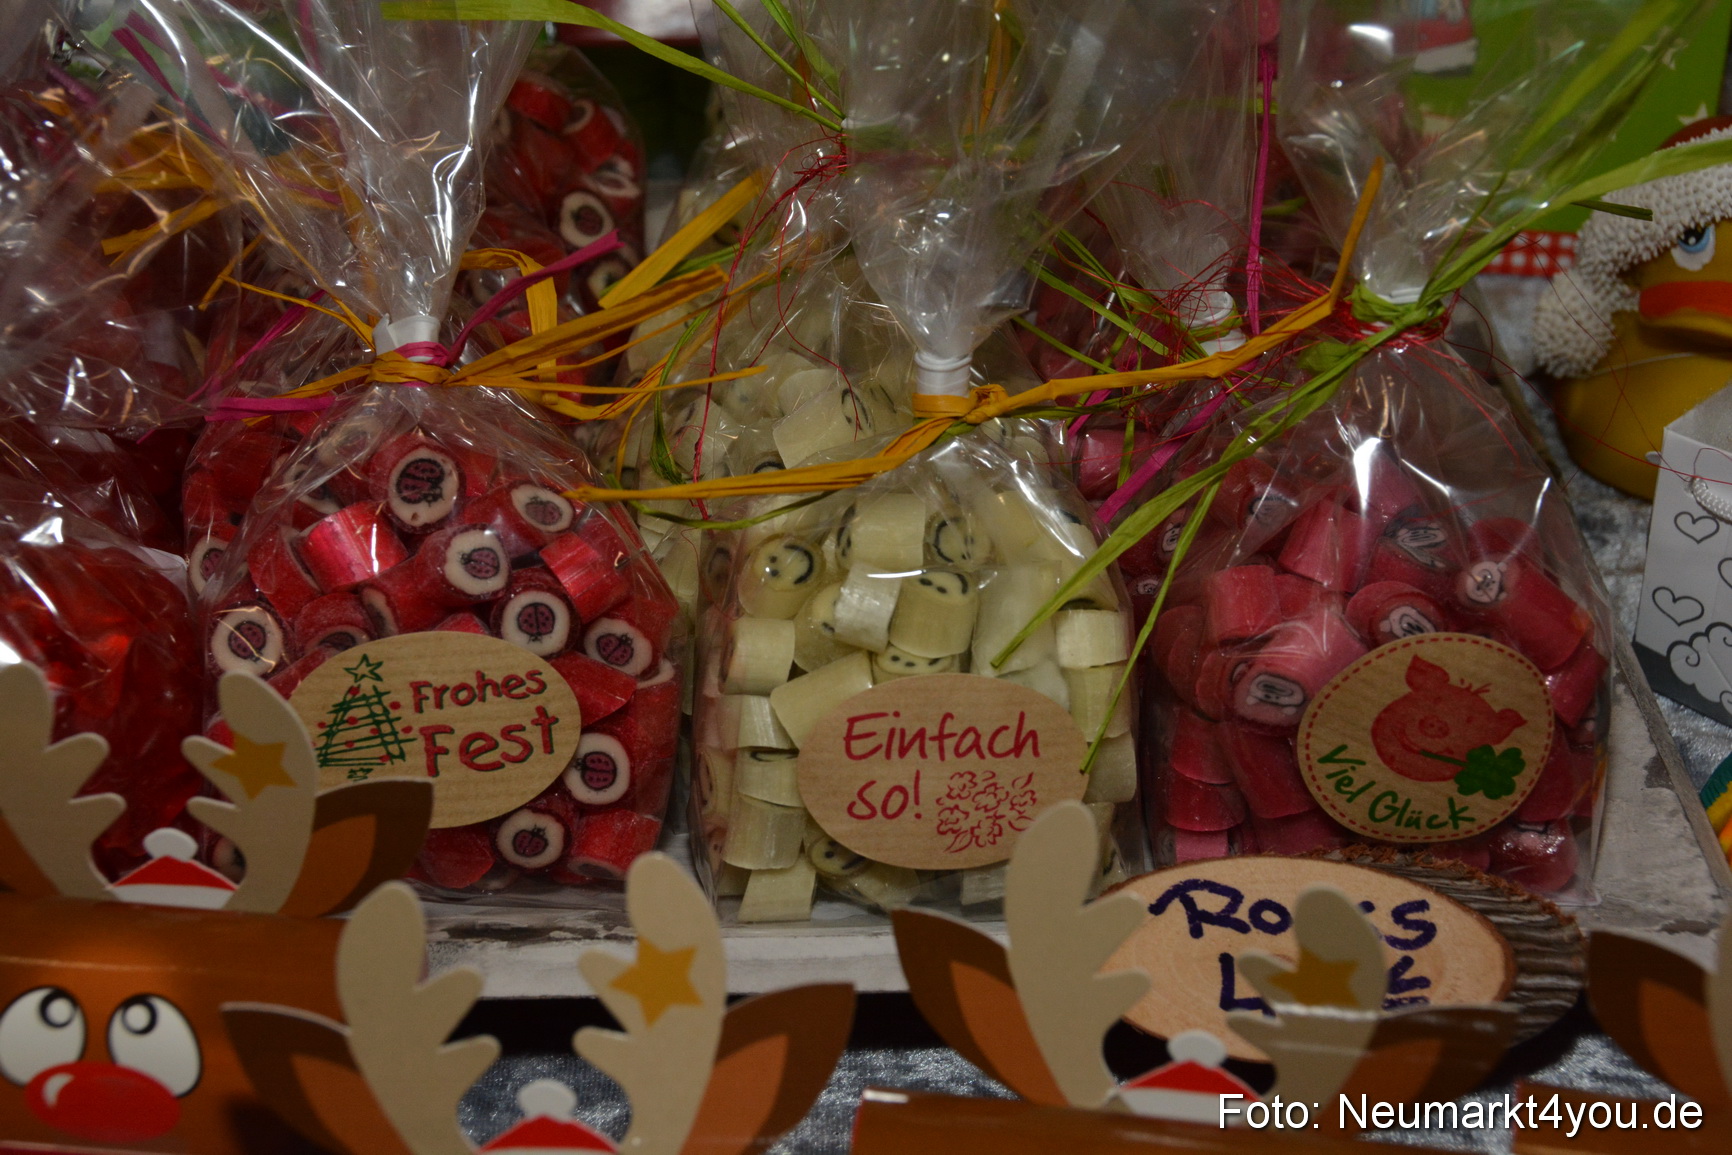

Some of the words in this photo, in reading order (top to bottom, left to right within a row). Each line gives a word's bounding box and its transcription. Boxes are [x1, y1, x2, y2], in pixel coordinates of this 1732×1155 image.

[409, 669, 547, 714] Frohes
[418, 705, 559, 777] Fest
[843, 710, 1040, 762] Einfach
[846, 769, 922, 820] so!
[1317, 744, 1376, 803] Viel
[1367, 796, 1476, 830] Glück
